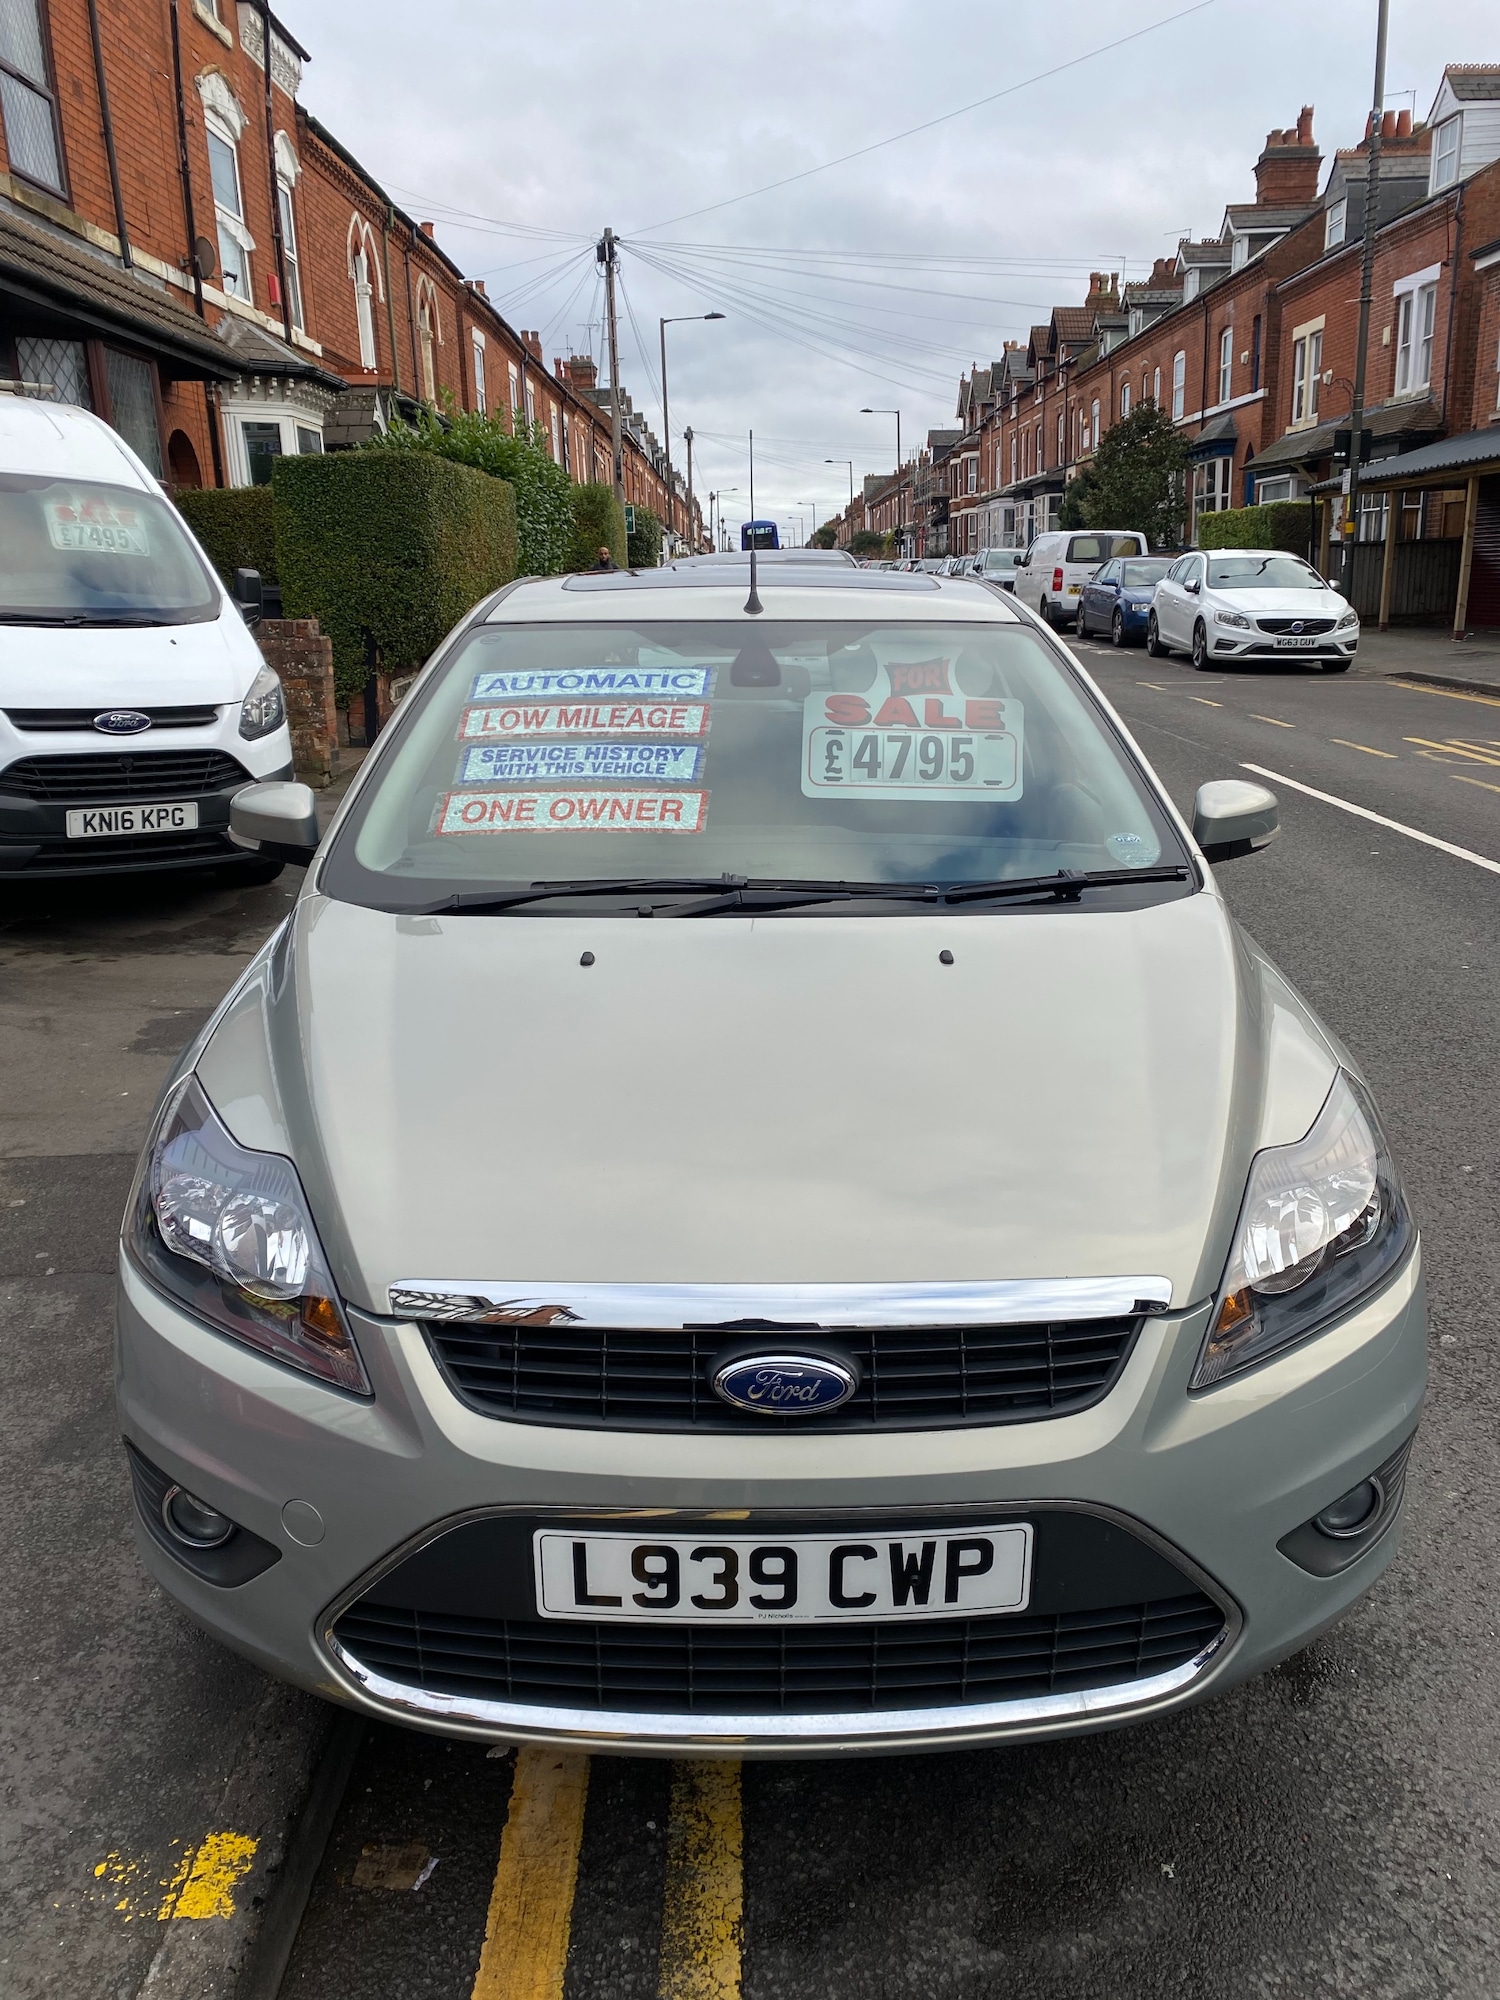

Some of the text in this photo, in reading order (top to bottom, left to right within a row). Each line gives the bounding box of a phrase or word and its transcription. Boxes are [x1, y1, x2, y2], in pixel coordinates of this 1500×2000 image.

[484, 673, 697, 693] AUTOMATIC
[892, 664, 941, 691] FOR
[108, 714, 140, 728] Ford
[481, 707, 688, 732] LOW MILEAGE
[824, 694, 1006, 730] SALE
[480, 746, 685, 764] SERVICE HISTORY
[824, 734, 975, 781] £4795
[493, 761, 667, 776] WITH THIS VEHICLE
[82, 807, 184, 834] KN16 KPG
[461, 798, 684, 824] ONE OWNER
[747, 1369, 823, 1401] Ford
[572, 1538, 995, 1610] L939 CWP
